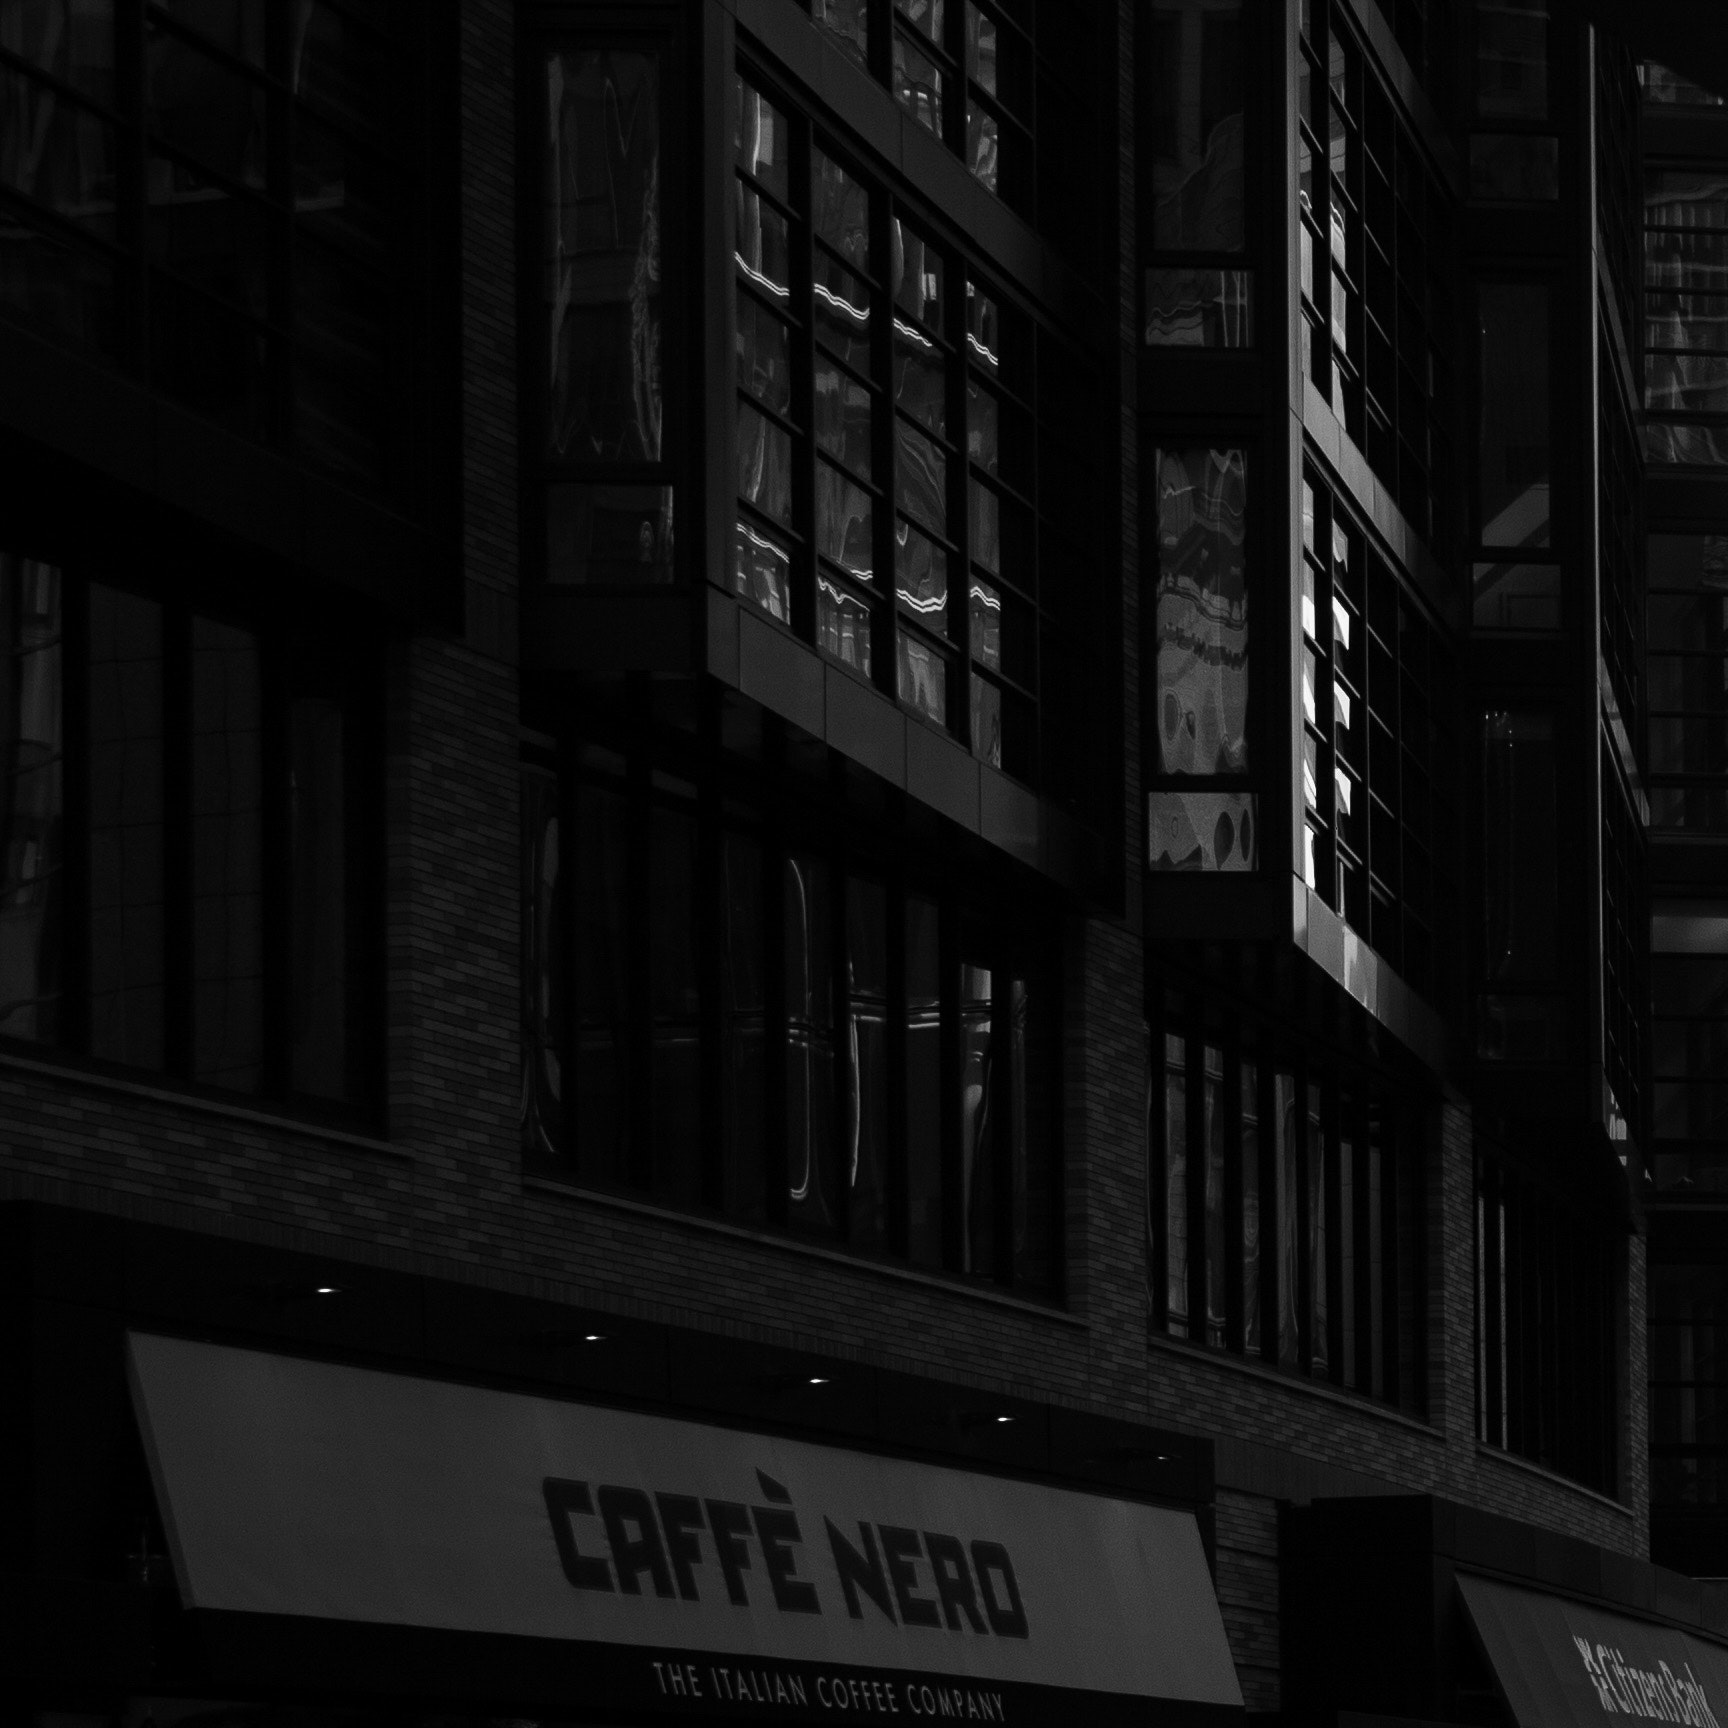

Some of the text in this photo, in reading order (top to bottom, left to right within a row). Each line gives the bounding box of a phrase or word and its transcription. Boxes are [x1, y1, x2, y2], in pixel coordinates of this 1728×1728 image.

[541, 1466, 1030, 1640] CAFFÈ NERO
[653, 1662, 1007, 1723] THE ITALIAN COFFEE COMPANY
